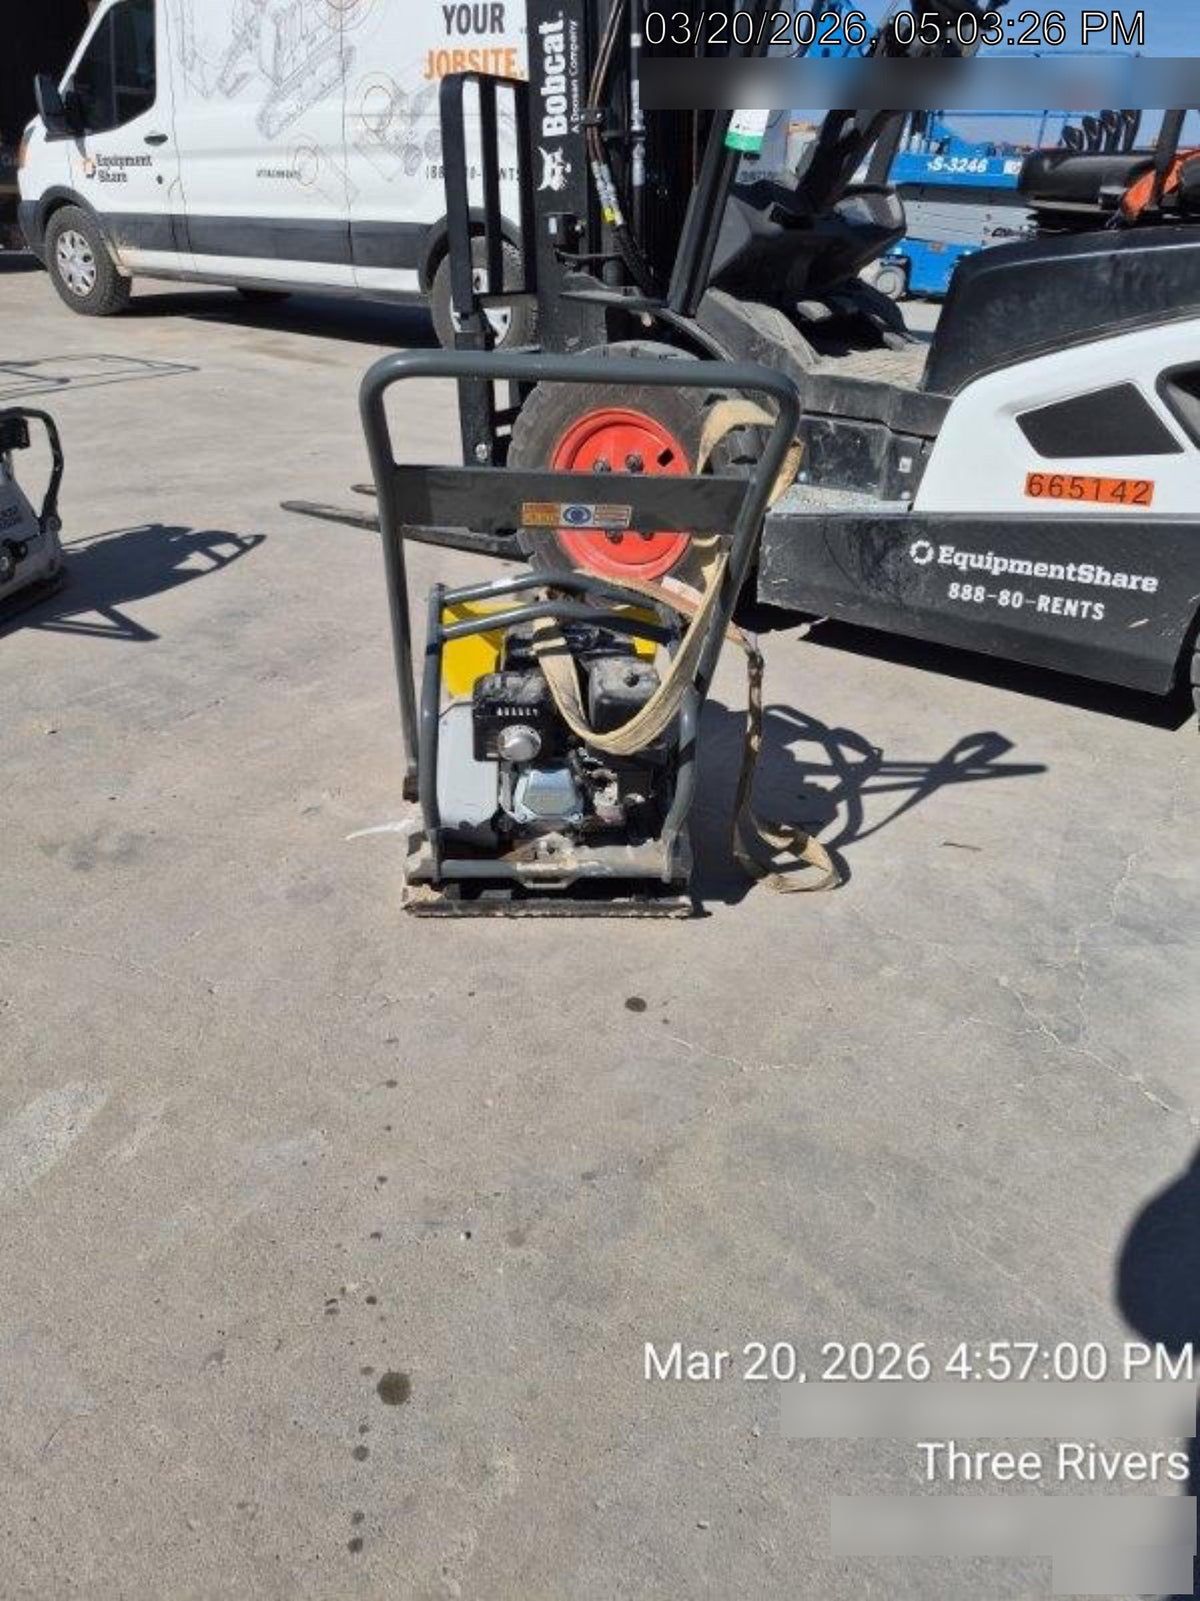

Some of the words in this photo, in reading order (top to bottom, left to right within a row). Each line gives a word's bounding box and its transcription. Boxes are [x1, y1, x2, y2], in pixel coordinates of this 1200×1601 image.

[442, 3, 506, 35] YOUR
[568, 20, 580, 76] Company
[538, 20, 568, 137] Bobcat
[96, 153, 153, 169] Equipment
[97, 169, 128, 183] Share
[1027, 473, 1152, 504] 665142
[937, 545, 1159, 594] EquipmentShare
[948, 582, 1105, 620] 888-80-RENTS
